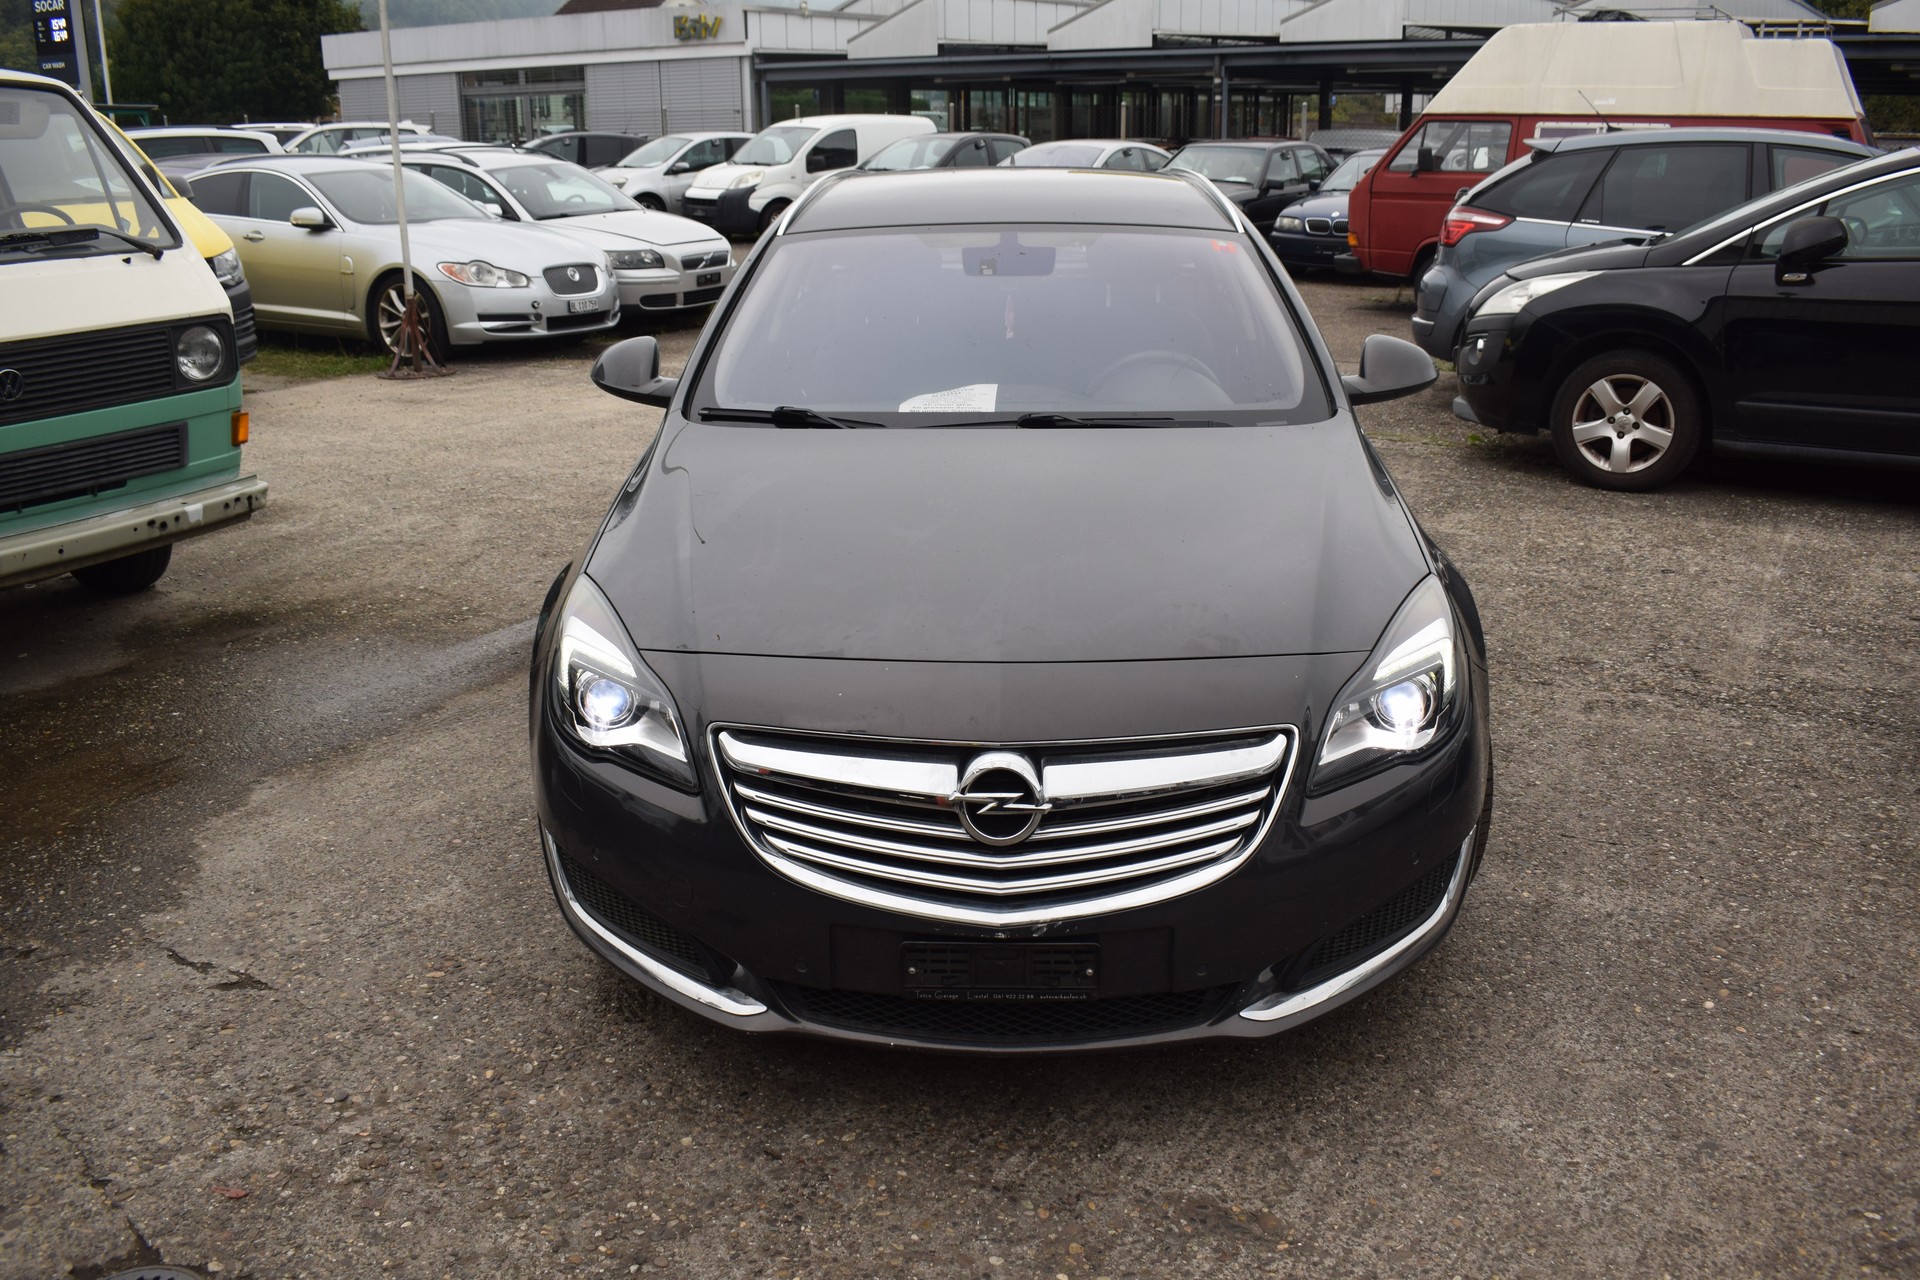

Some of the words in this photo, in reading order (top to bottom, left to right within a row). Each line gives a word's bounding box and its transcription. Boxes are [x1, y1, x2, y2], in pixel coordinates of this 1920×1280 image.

[34, 0, 65, 13] SOCAR
[42, 62, 52, 70] CAR
[52, 61, 66, 69] WASH
